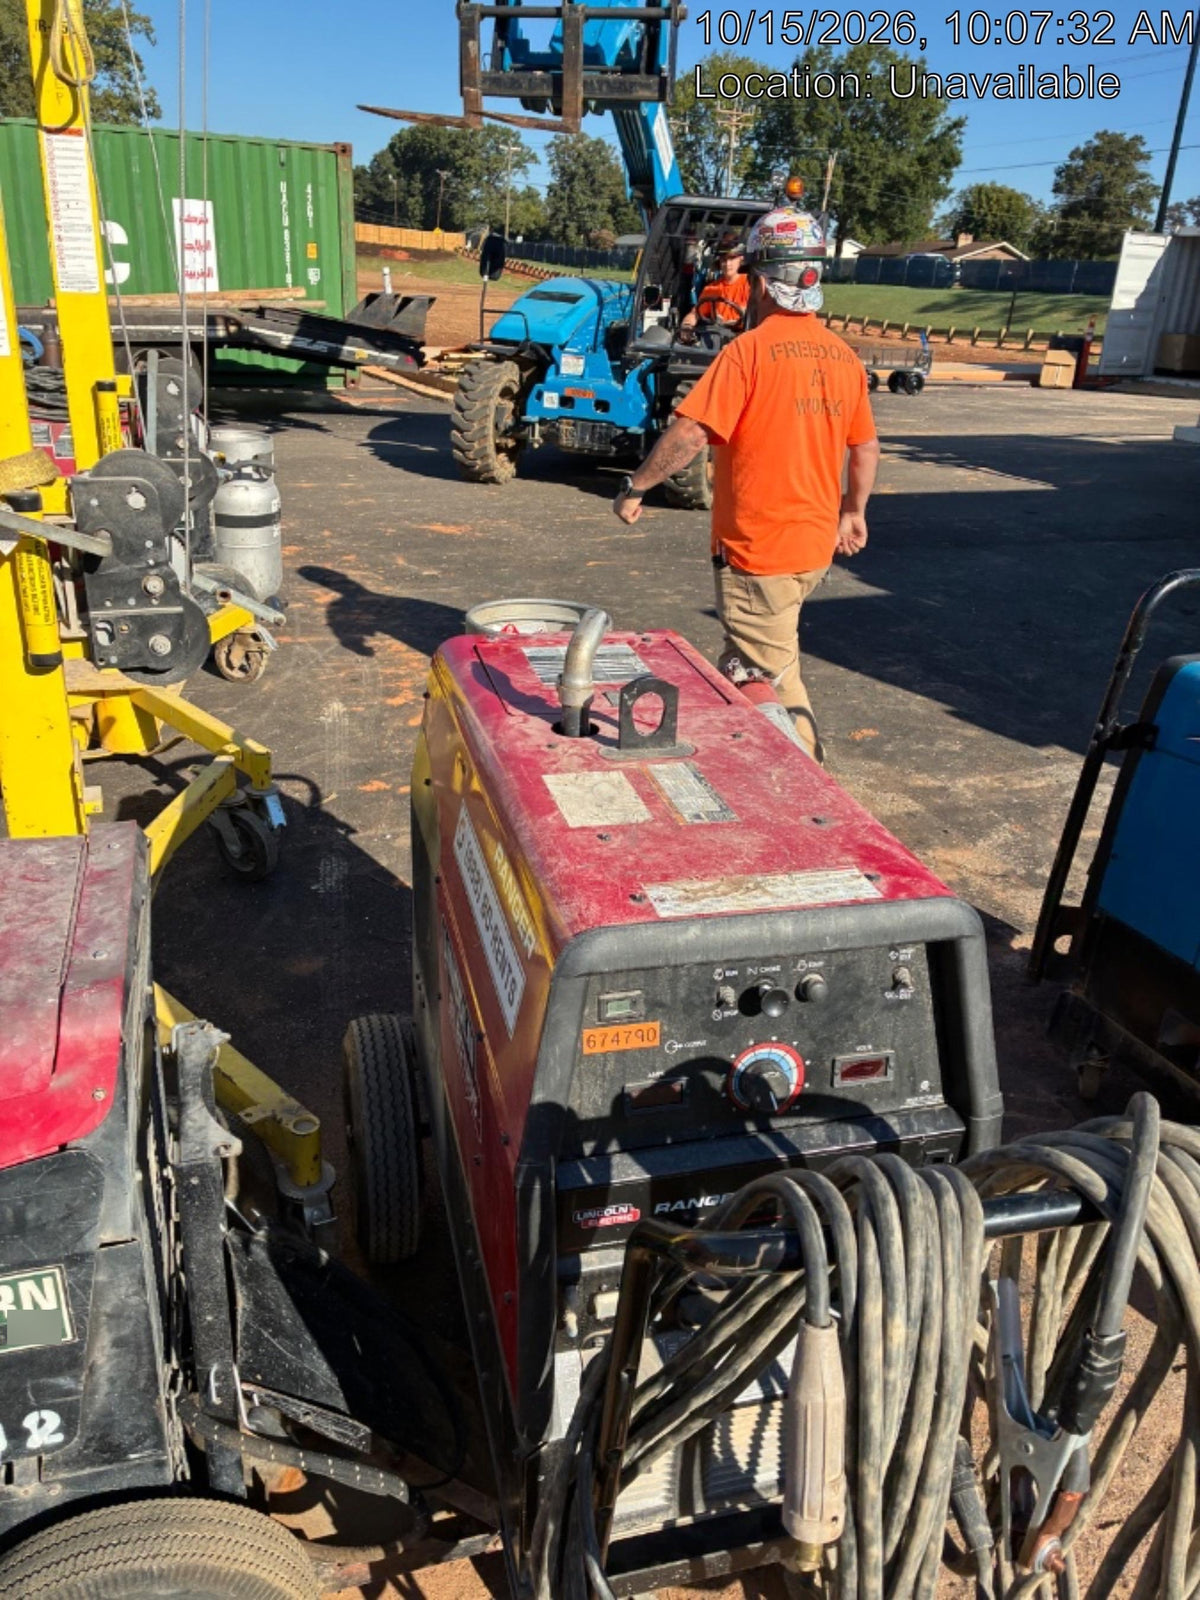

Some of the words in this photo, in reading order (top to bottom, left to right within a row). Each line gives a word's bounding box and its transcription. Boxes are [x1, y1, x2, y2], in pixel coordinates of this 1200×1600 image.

[770, 340, 854, 365] FREEDOM
[796, 398, 843, 416] WORK
[494, 840, 537, 960] RANGER
[586, 1027, 657, 1049] 674790
[576, 1204, 631, 1221] LINCOLN
[654, 1192, 735, 1215] RANGE
[588, 1213, 634, 1227] ELECTRIC
